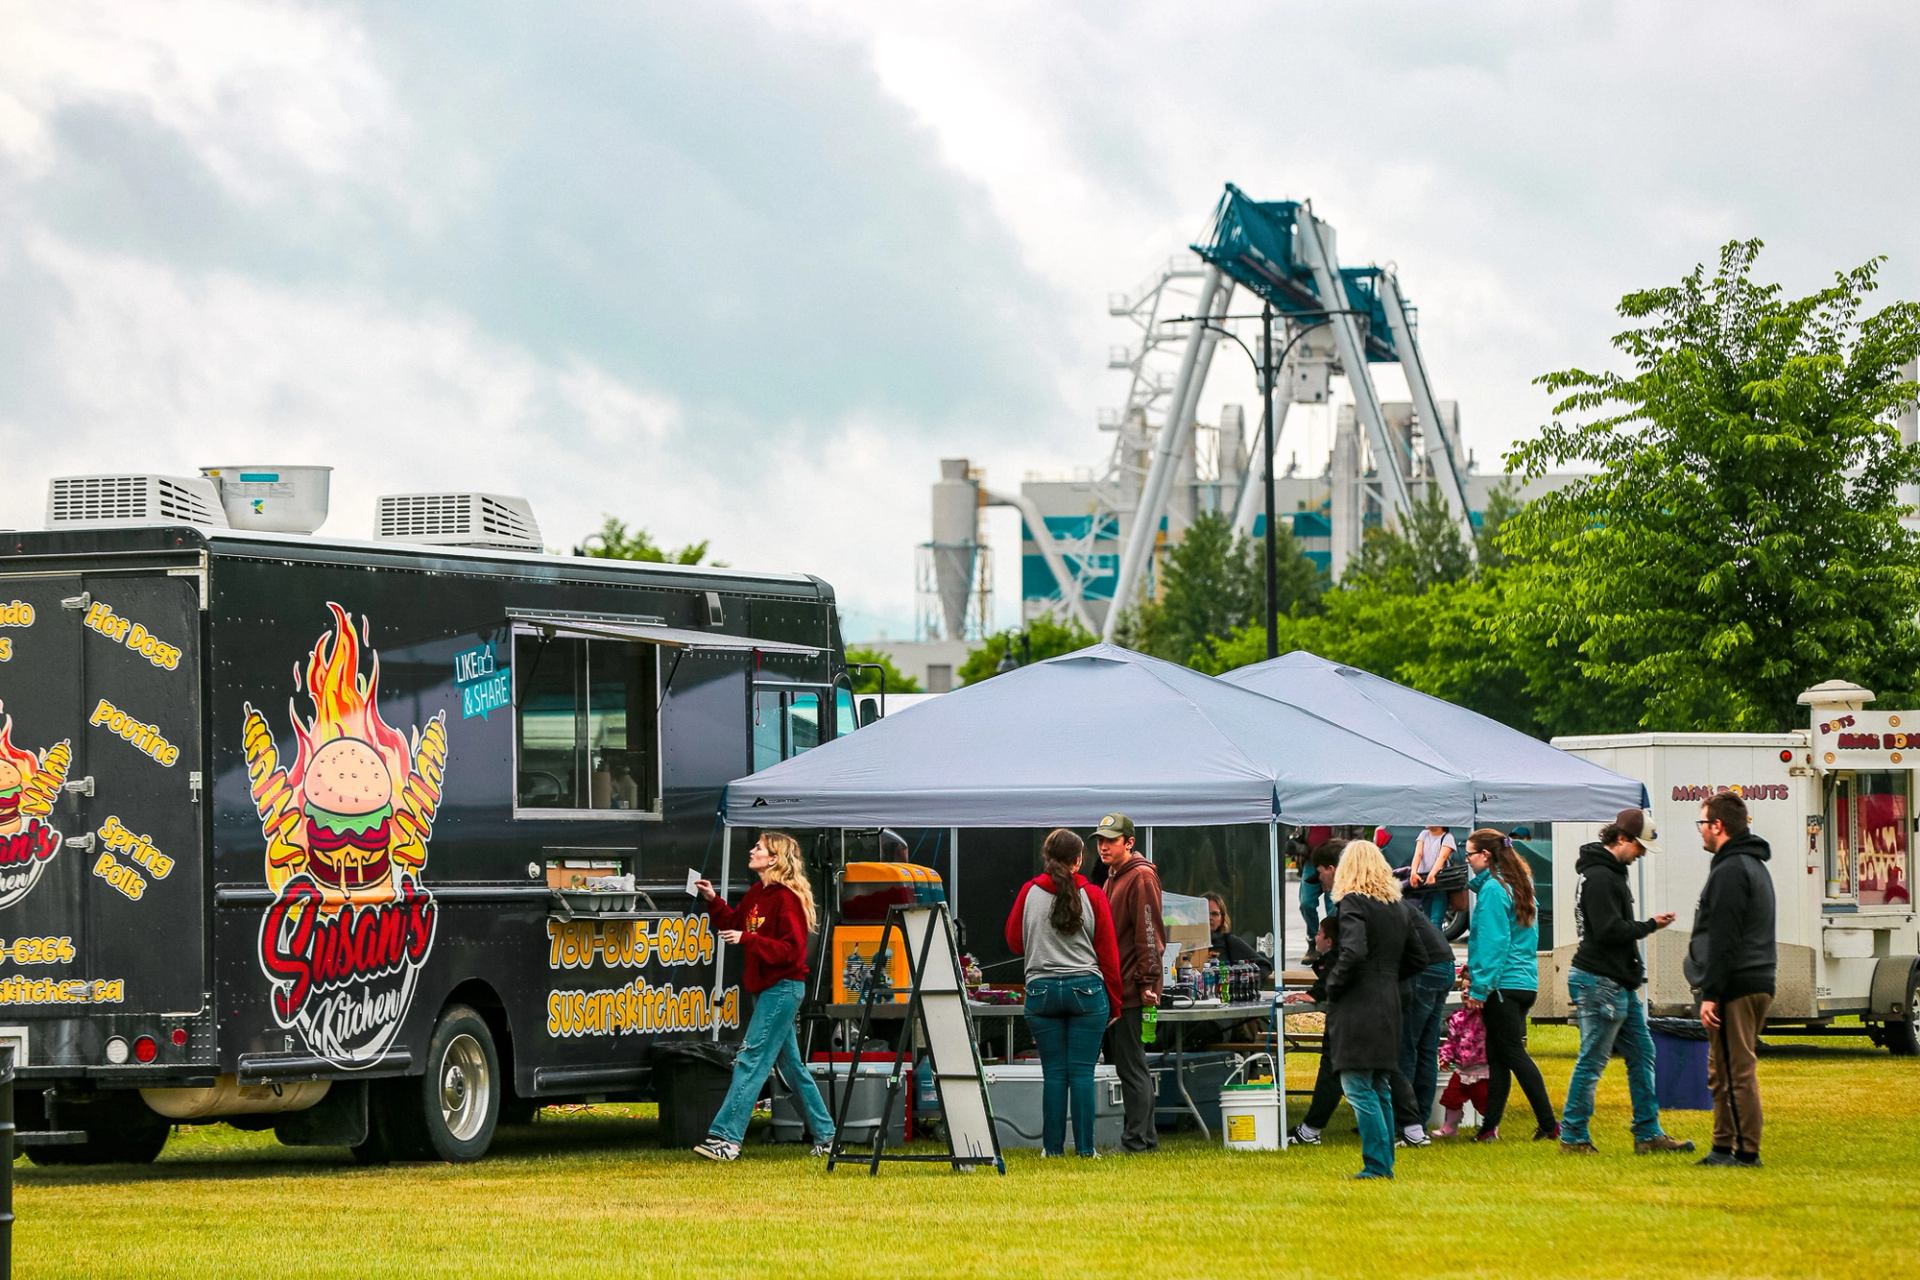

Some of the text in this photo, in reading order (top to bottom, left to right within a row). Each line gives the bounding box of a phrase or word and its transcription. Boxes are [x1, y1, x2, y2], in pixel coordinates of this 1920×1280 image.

[84, 601, 182, 671] Hot Dogs
[456, 652, 479, 683] LIKE
[464, 676, 508, 715] & SHARE
[93, 851, 147, 901] Rolls
[98, 816, 175, 879] Spring
[262, 876, 434, 1020] Susan's
[547, 913, 715, 969] 780-805-6264
[308, 986, 401, 1061] Kitchen
